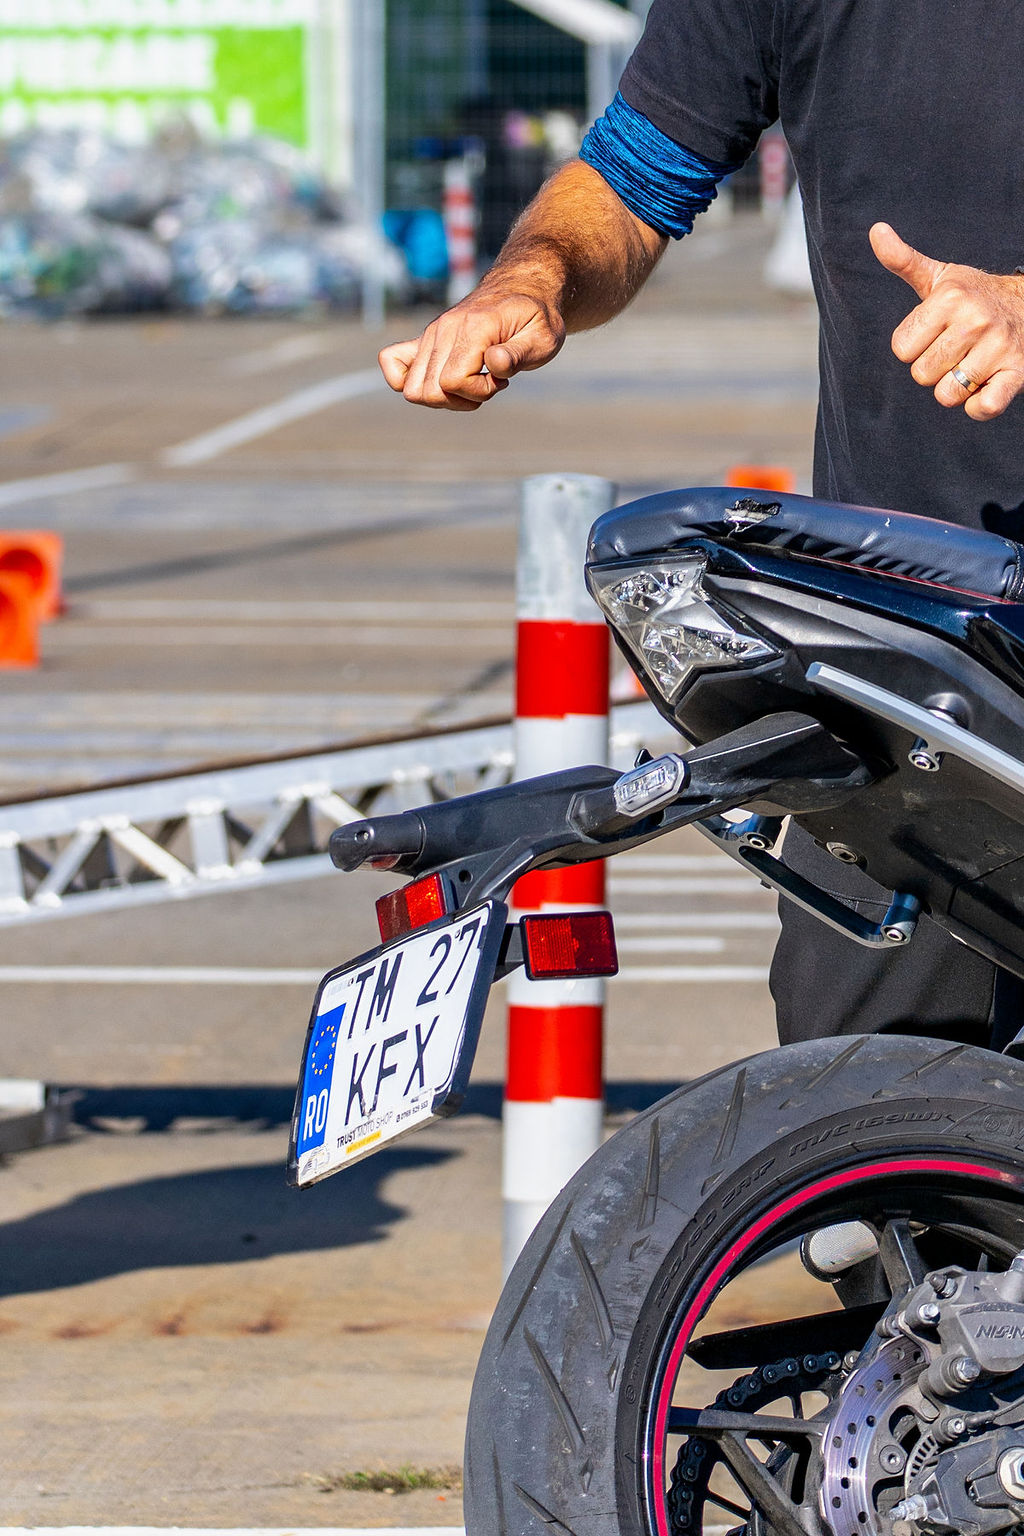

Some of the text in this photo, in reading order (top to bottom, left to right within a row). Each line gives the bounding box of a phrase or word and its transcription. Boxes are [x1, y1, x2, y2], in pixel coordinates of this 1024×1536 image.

[347, 917, 481, 1040] TM 27
[344, 1015, 440, 1126] KFX
[303, 1088, 328, 1141] RO
[337, 1128, 357, 1148] TRUST
[375, 1111, 394, 1129] SHOP
[789, 1123, 851, 1158] M/C
